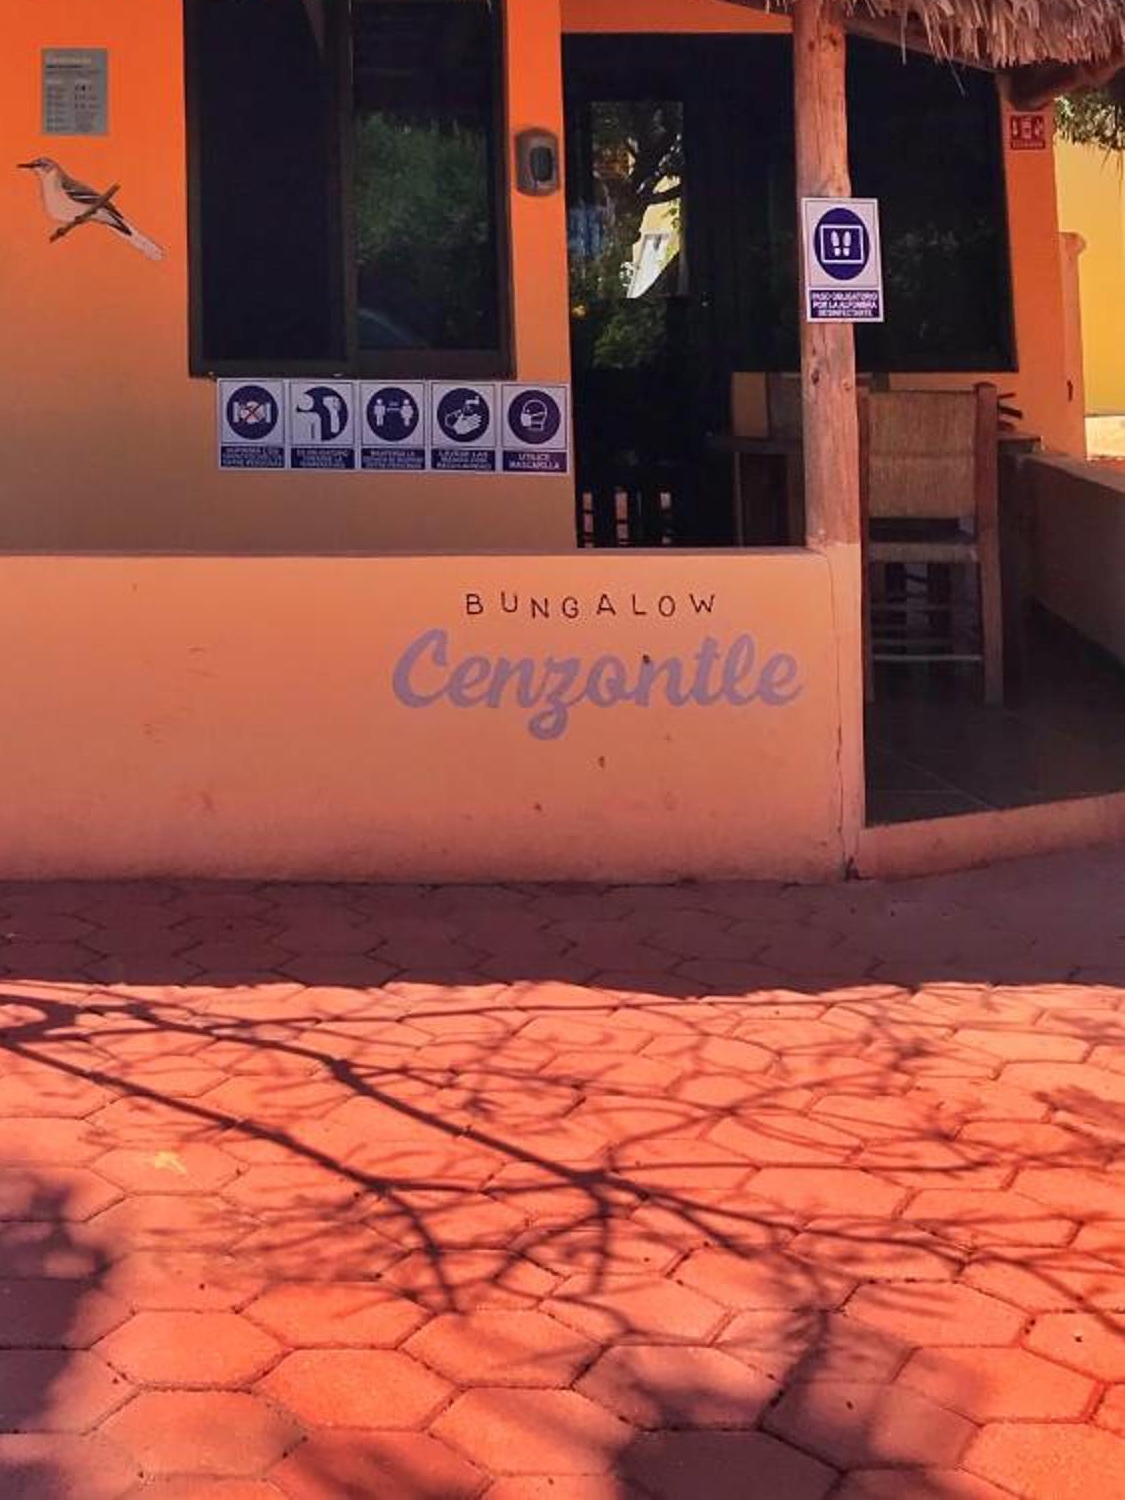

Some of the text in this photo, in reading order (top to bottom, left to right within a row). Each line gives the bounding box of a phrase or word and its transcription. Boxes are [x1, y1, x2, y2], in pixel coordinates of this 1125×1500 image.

[518, 453, 550, 461] UTILICE
[465, 592, 716, 619] BUNGALOW
[392, 628, 803, 741] Cenzontle
